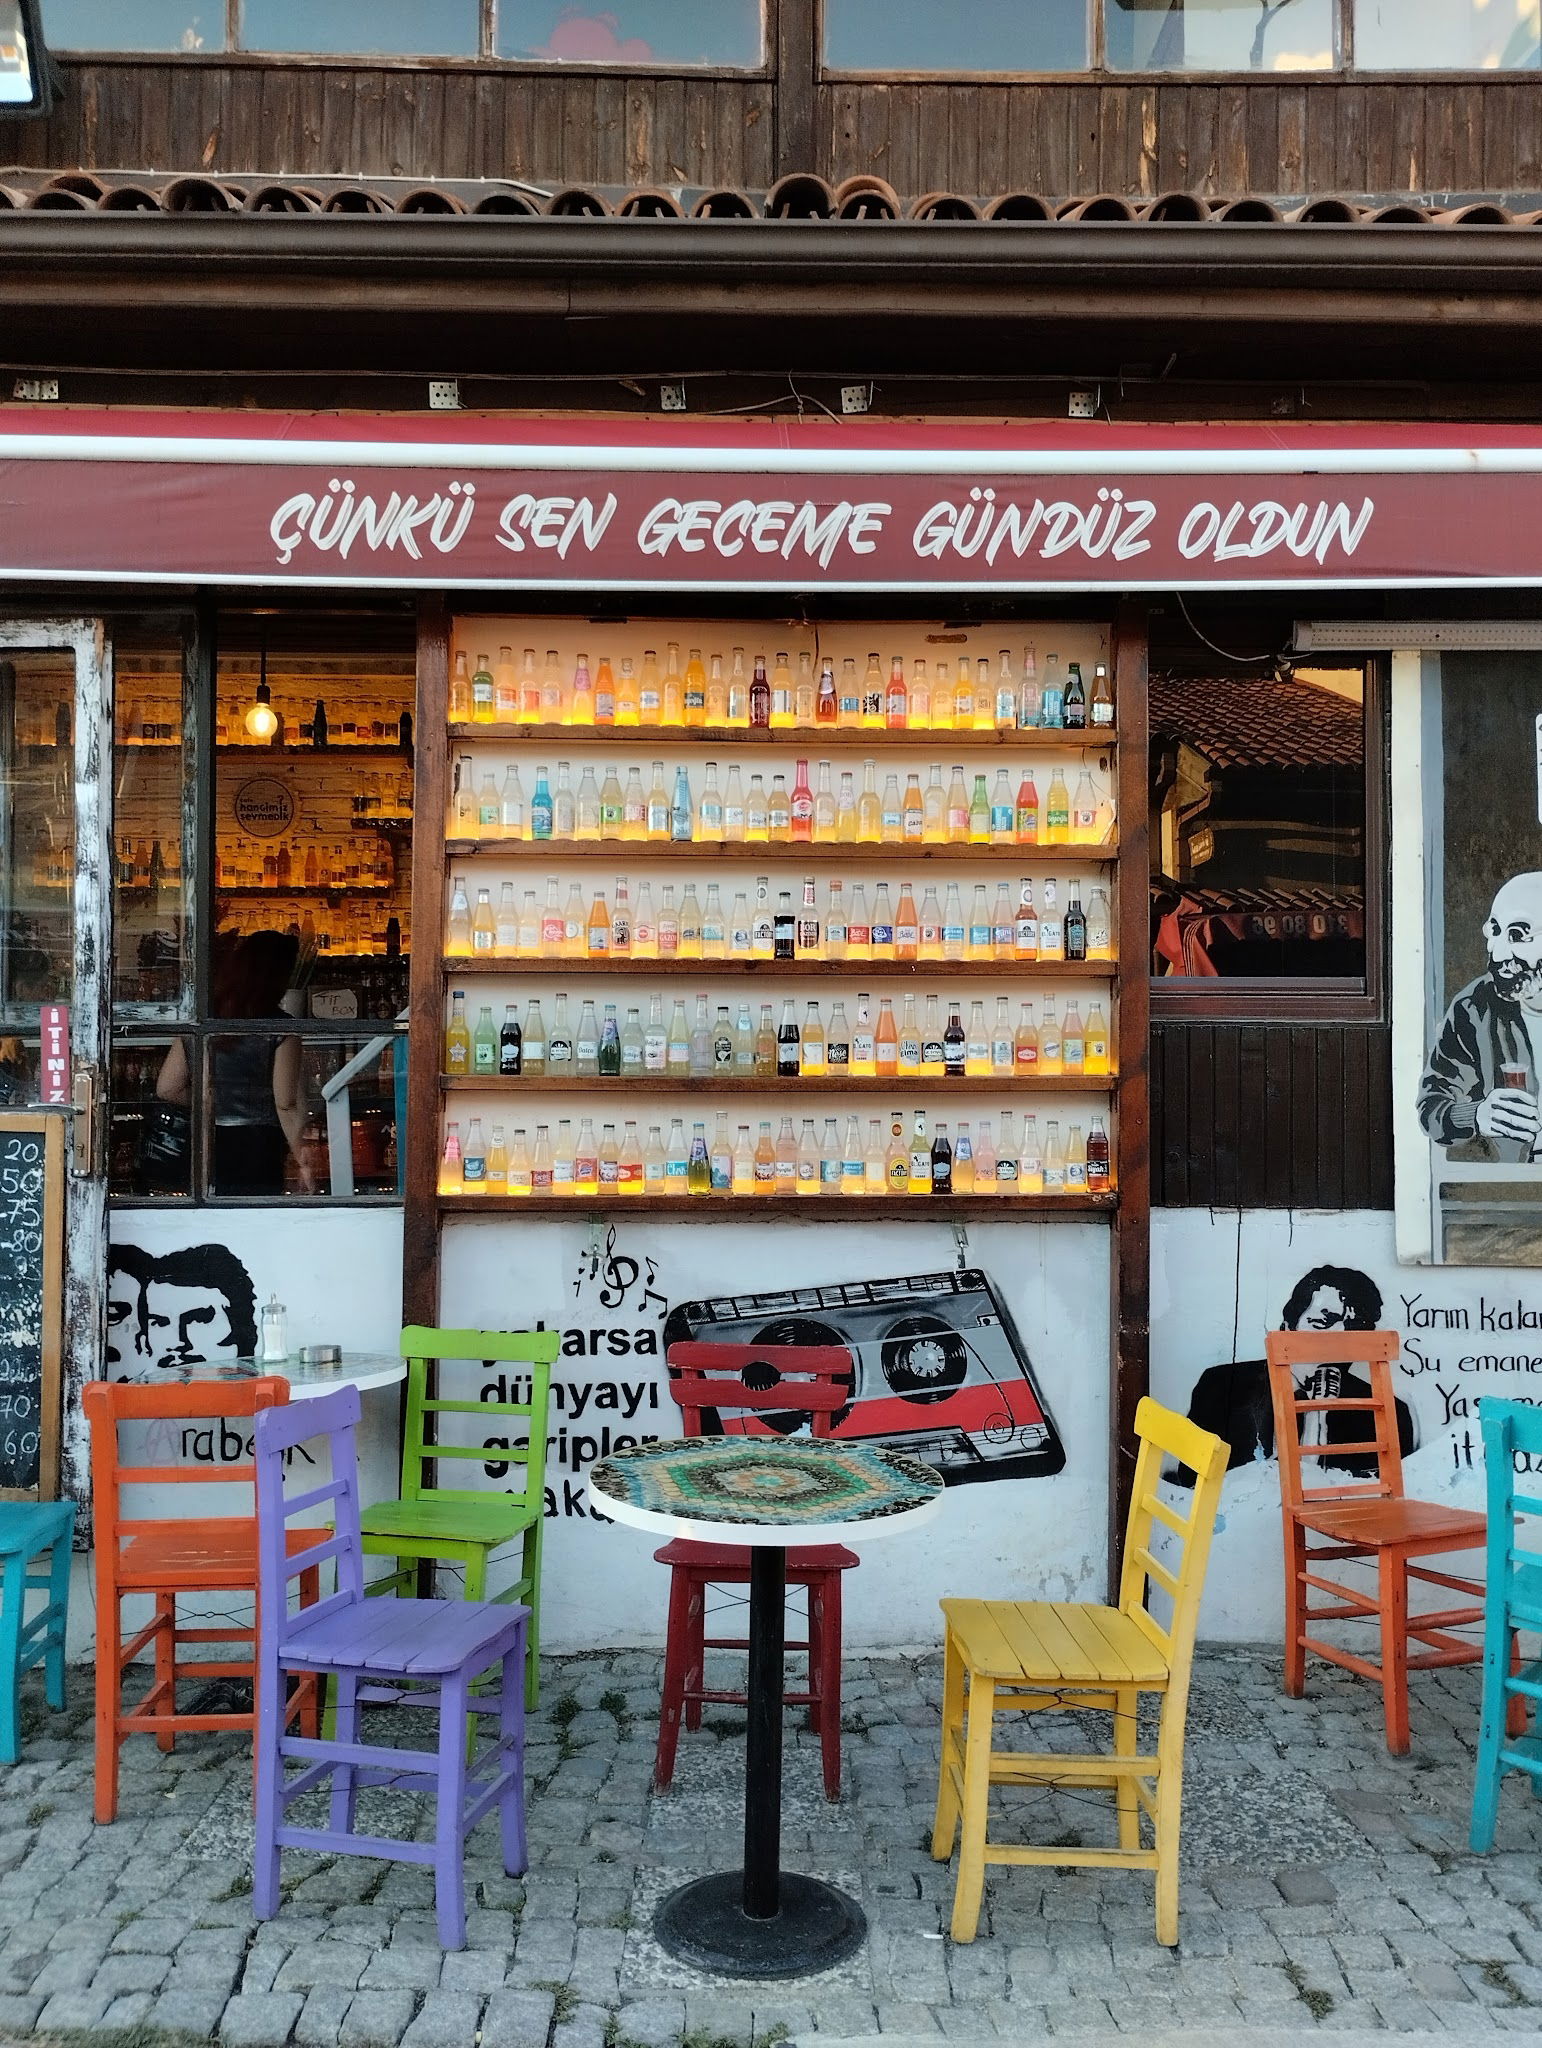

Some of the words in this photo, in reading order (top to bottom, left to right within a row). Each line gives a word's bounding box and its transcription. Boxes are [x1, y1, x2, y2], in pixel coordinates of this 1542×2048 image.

[270, 478, 475, 564] ÇÜNKÜ
[495, 492, 617, 560] SEN
[637, 498, 892, 570] GECEME
[912, 487, 1157, 566] GÜNDÜZ
[1178, 497, 1374, 565] OLDUN
[4, 1139, 39, 1162] 20
[1400, 1293, 1469, 1331] Yarım
[1480, 1296, 1542, 1332] kala
[480, 1320, 658, 1368] arsa
[1400, 1338, 1441, 1378] Şu
[5, 1429, 38, 1455] 60
